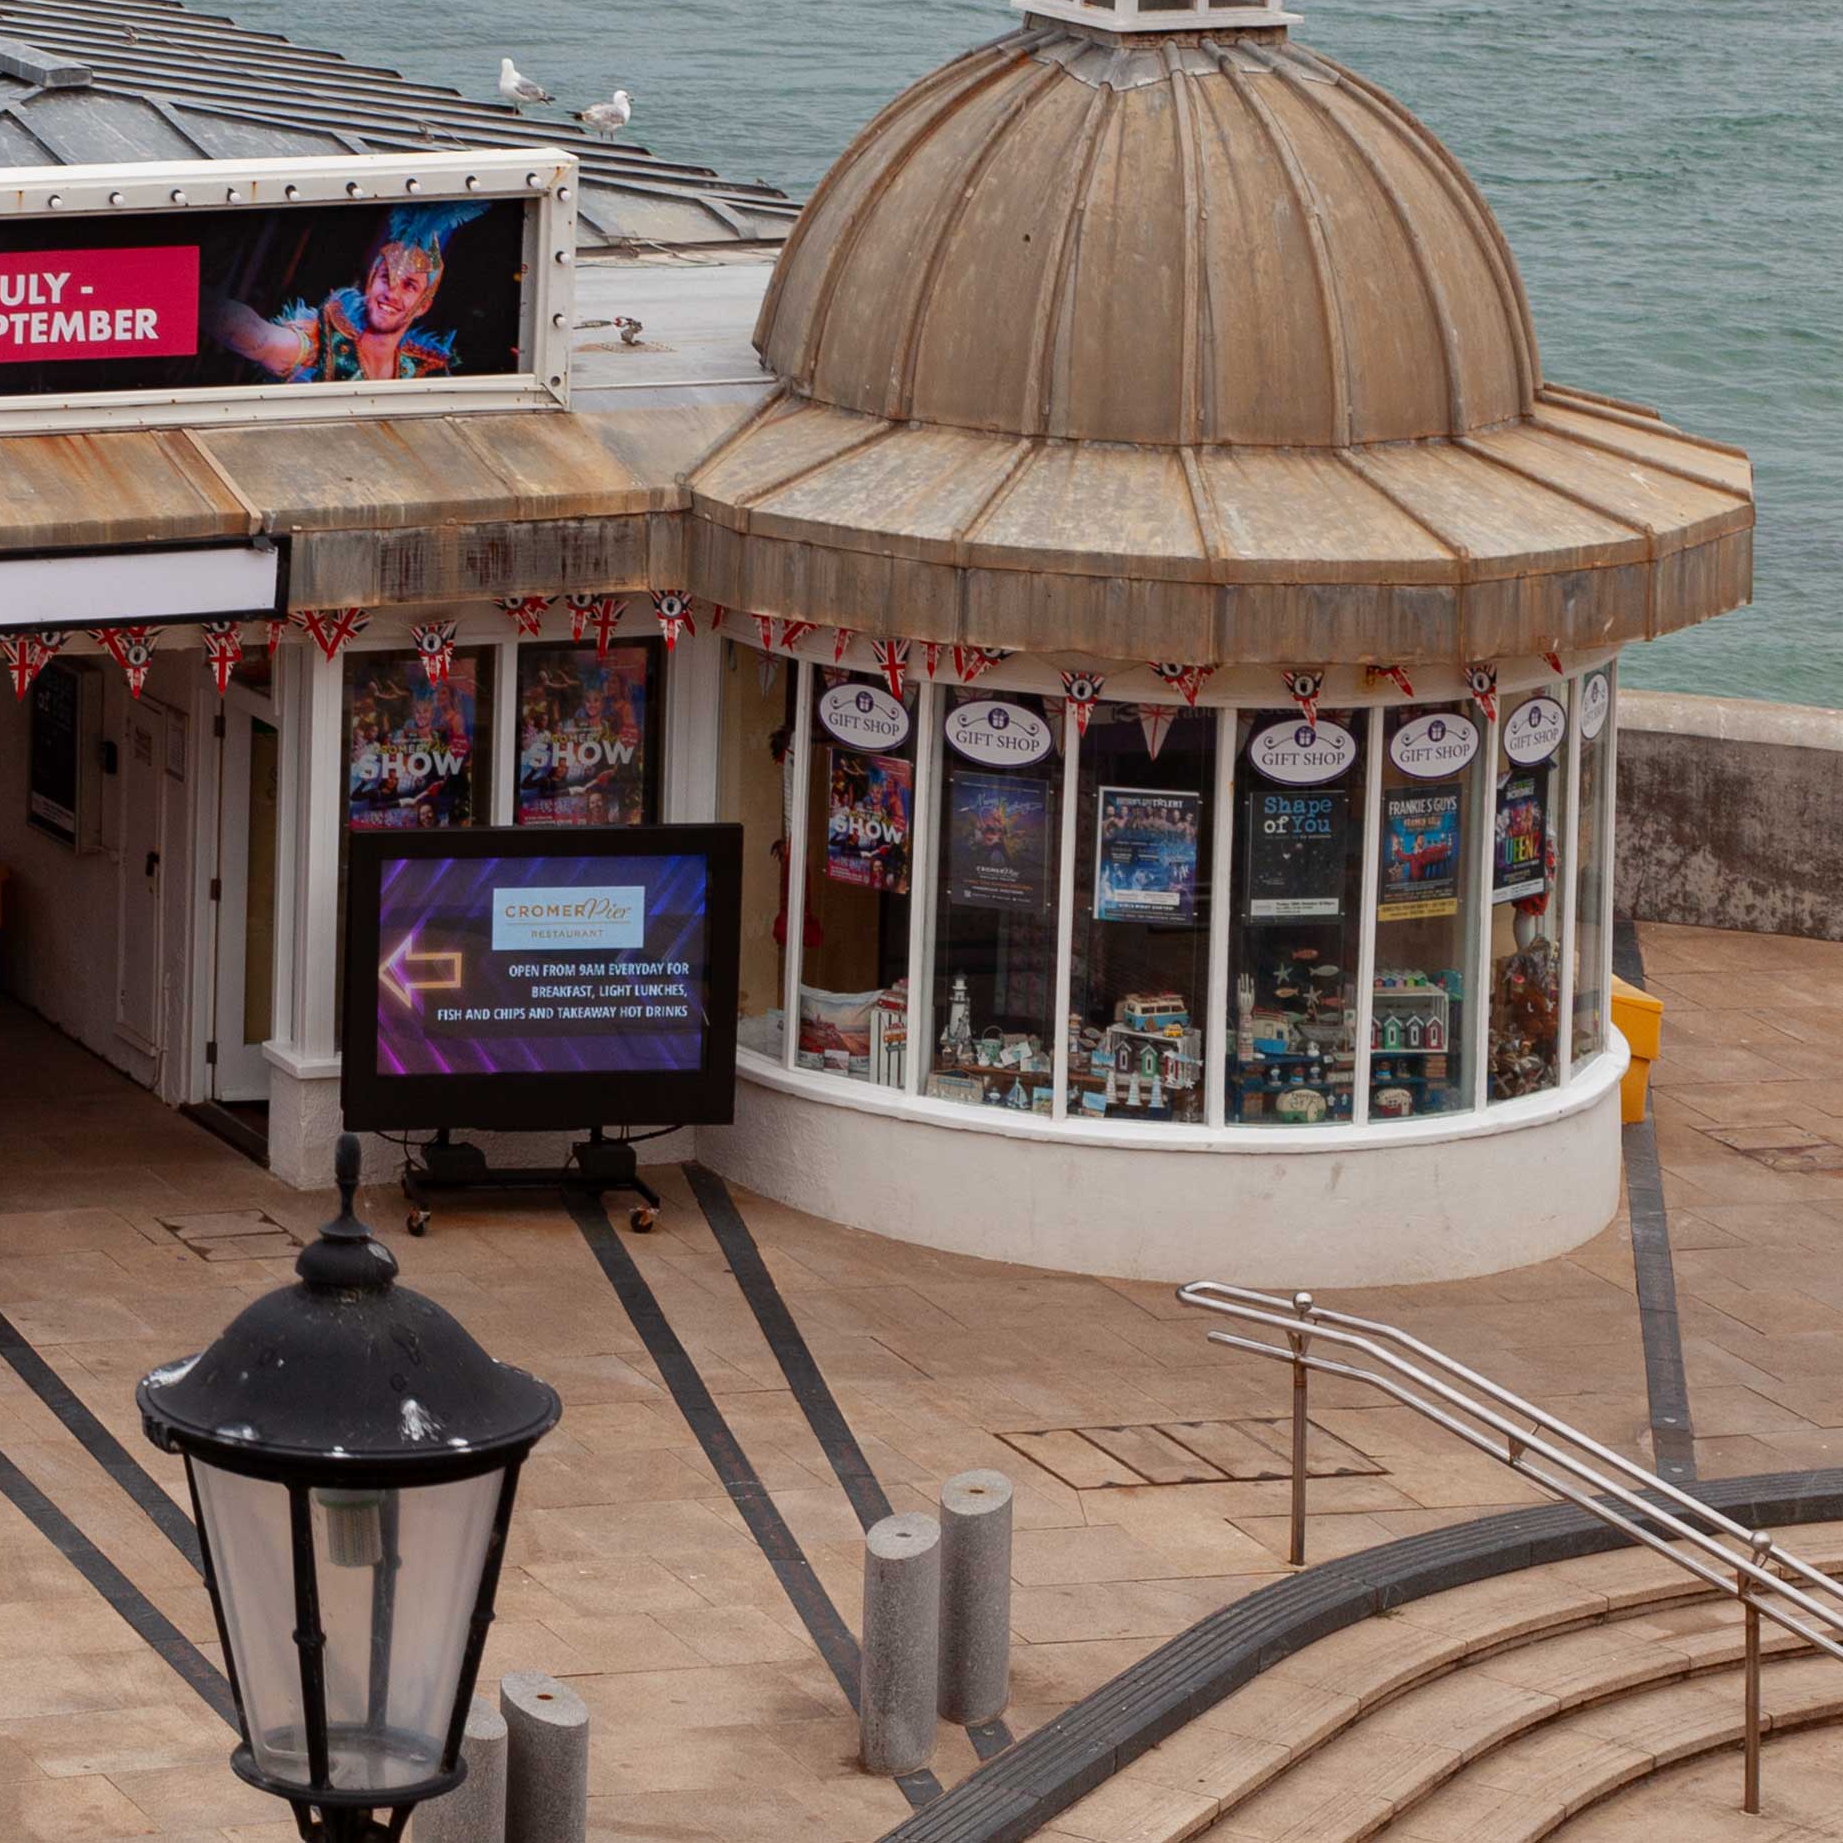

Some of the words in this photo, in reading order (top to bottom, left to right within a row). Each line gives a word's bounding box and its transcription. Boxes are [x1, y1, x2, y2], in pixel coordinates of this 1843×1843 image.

[828, 711, 863, 730] GIFT
[863, 719, 900, 737] SHOP
[956, 729, 994, 747] GIFT
[997, 734, 1041, 753] SHOP
[1510, 734, 1533, 751] GIFT
[1533, 728, 1559, 746] SHOP
[530, 740, 634, 768] SHOW
[1261, 752, 1300, 766] GIFT
[1303, 752, 1346, 766] SHOP
[1399, 748, 1434, 763] GIFT
[1435, 743, 1470, 761] SHOP
[360, 751, 463, 779] SHOW
[1264, 797, 1333, 815] Shape
[831, 812, 903, 845] SHOW
[1264, 815, 1289, 834] of
[1292, 816, 1332, 833] You
[505, 904, 585, 918] CROMER
[584, 897, 631, 920] Pier
[531, 929, 603, 939] RESTAURANT
[509, 964, 539, 977] OPEN
[543, 963, 575, 976] FROM
[579, 963, 605, 976] 9AM
[609, 962, 664, 975] EVERYDAY
[667, 962, 689, 975] FOR
[531, 985, 595, 999] BREAKFAST,
[599, 985, 631, 997] LIGHT
[634, 984, 688, 998] LUNCHES,
[437, 1009, 462, 1021] FISH
[465, 1008, 490, 1020] AND
[494, 1008, 526, 1020] CHIPS
[529, 1007, 554, 1019] AND
[558, 1006, 616, 1018] TAKEAWAY
[620, 1005, 643, 1018] HOT
[645, 1005, 688, 1018] DRINKS
